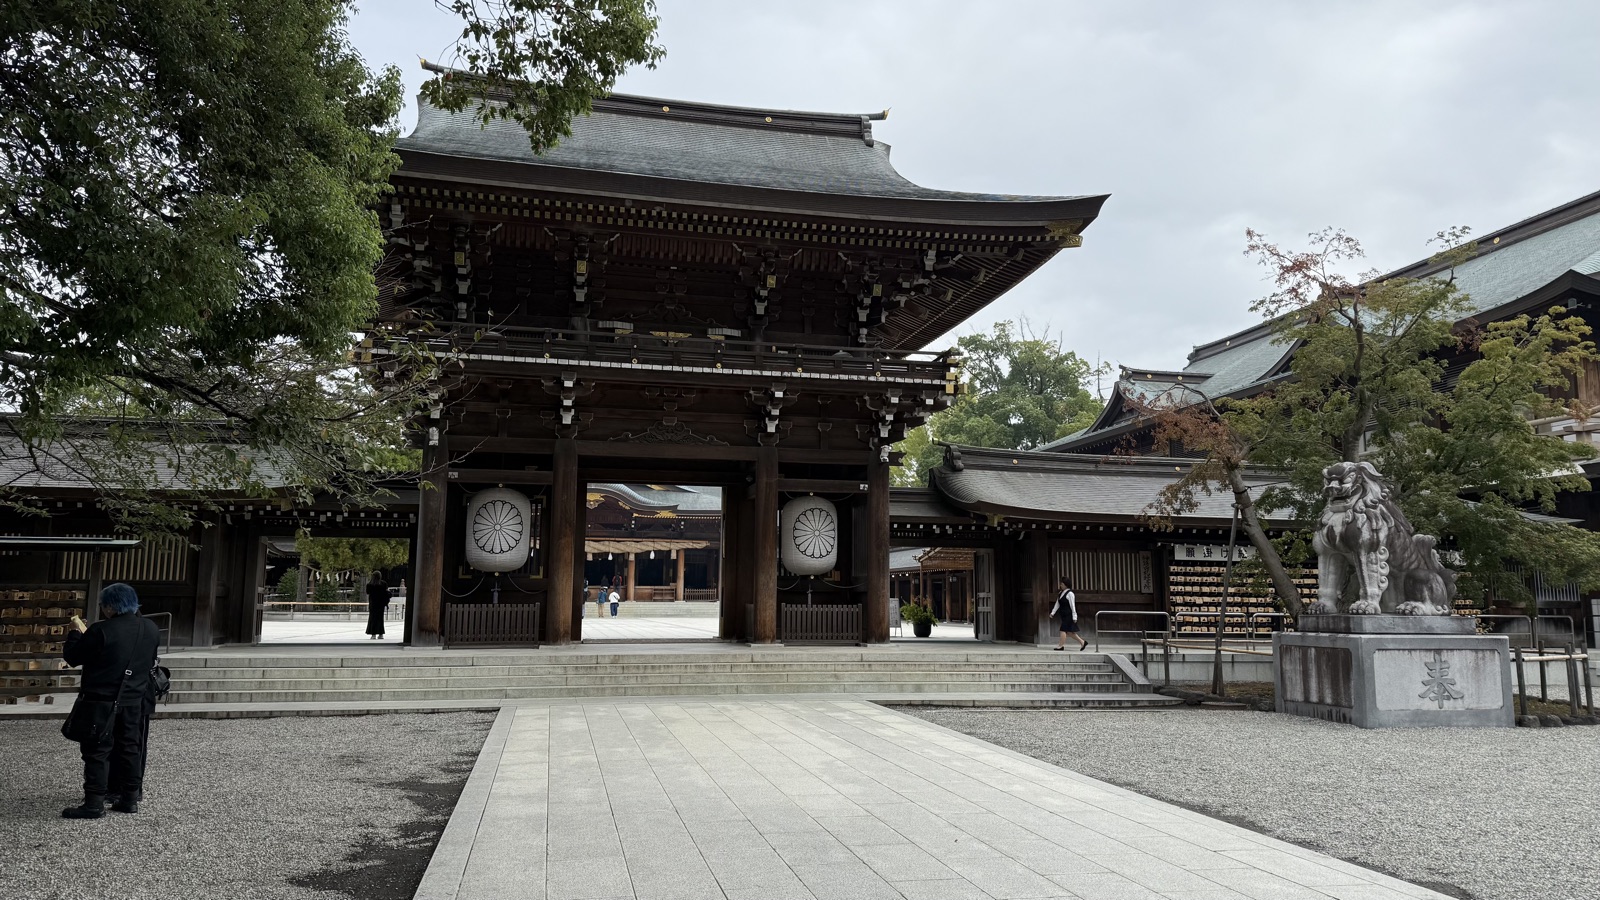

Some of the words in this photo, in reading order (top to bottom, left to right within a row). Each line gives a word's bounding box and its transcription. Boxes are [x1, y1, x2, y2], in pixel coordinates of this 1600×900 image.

[1186, 547, 1258, 559] 願掛け絵
[1418, 651, 1465, 709] 奉
